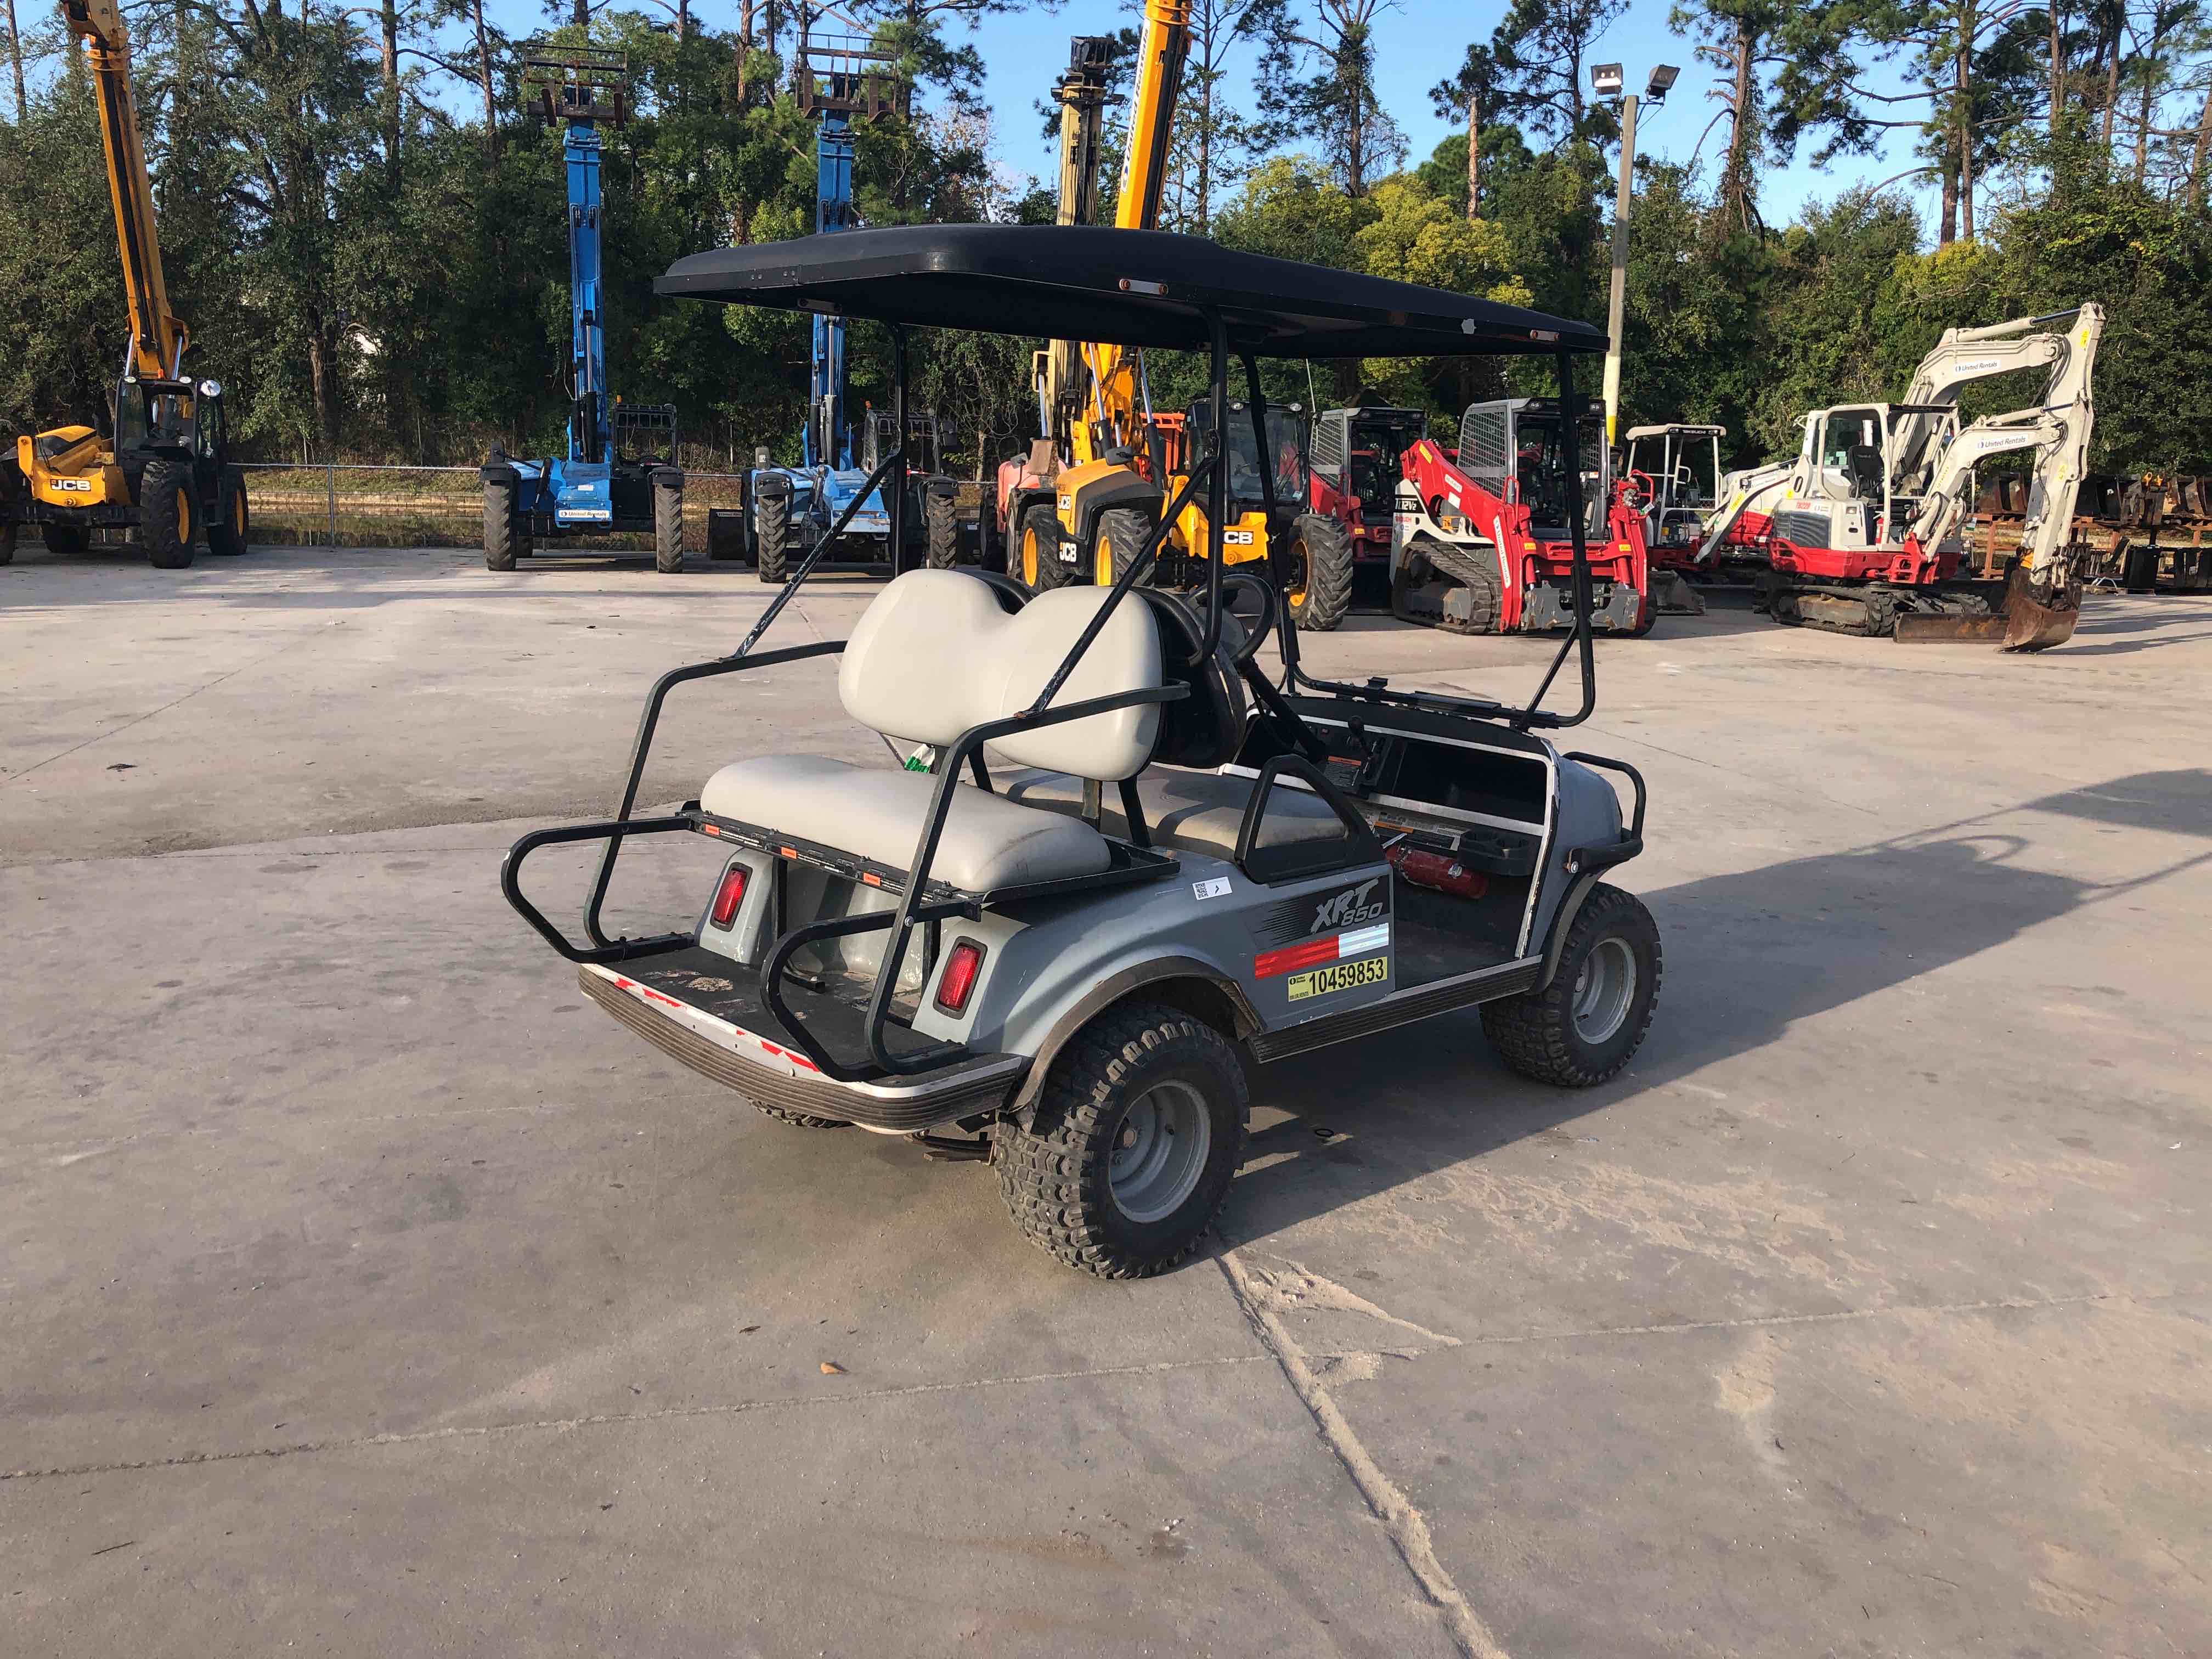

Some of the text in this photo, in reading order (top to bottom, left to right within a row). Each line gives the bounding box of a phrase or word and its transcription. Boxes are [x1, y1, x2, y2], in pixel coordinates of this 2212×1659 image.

[1126, 28, 1148, 161] United Rentals
[2005, 436, 2026, 445] Rentals
[51, 479, 91, 491] JCB
[1059, 495, 1071, 509] JCB
[1224, 531, 1253, 544] CB
[1059, 542, 1077, 562] JCB
[1310, 878, 1383, 934] XRT 850
[1309, 959, 1384, 995] 10459853
